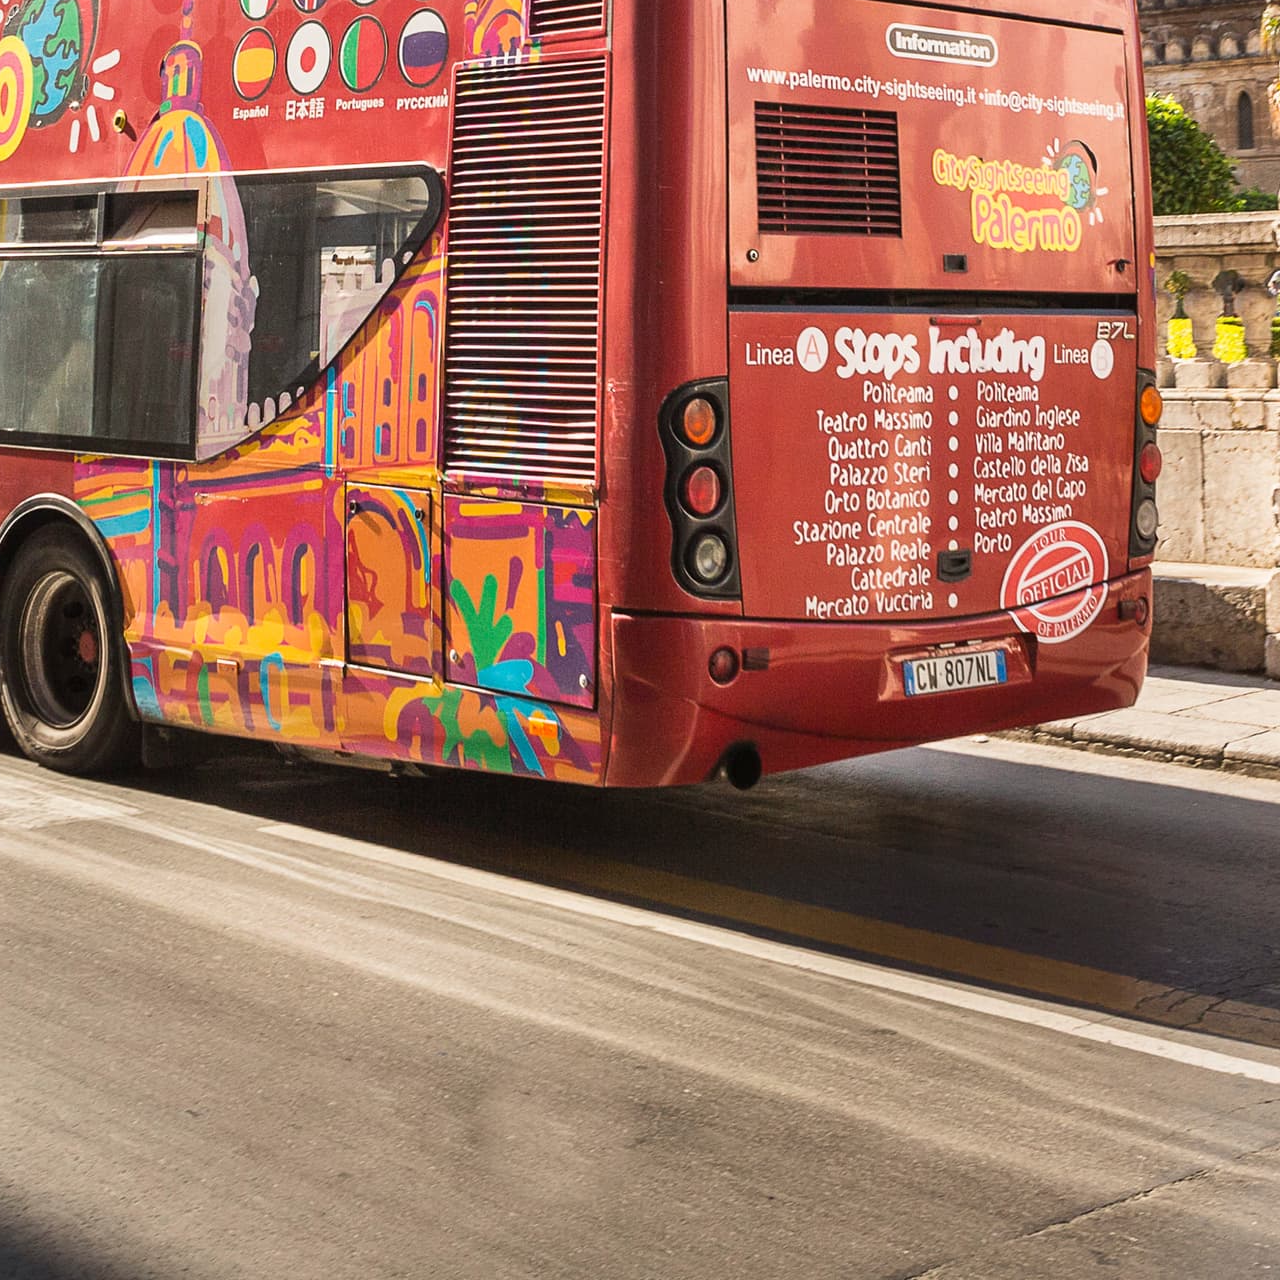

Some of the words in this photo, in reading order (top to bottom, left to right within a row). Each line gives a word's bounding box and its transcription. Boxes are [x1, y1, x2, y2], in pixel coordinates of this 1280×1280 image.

[895, 31, 991, 59] Information
[747, 67, 976, 107] www.palermo.city-sightseeing.it
[232, 105, 269, 120] Español
[285, 97, 325, 120] 日本語
[971, 189, 1082, 252] Palermo
[1096, 322, 1135, 339] B7L
[745, 342, 794, 366] Linea
[834, 326, 921, 381] Stops
[928, 326, 1046, 382] Including
[1053, 343, 1089, 364] Linea
[863, 380, 934, 404] Politeama
[977, 380, 1039, 403] Politeama
[816, 409, 868, 434] Teatro
[874, 408, 933, 431] Massimo
[976, 405, 1031, 428] Giardino
[1035, 404, 1081, 430] Inglese
[828, 436, 889, 462] Quattro
[894, 434, 932, 457] Canti
[975, 432, 1003, 454] Villa
[1008, 431, 1065, 452] Malfitano
[830, 462, 888, 487] Palazzo
[894, 461, 931, 485] Steri
[973, 456, 1026, 479] Castello
[1030, 454, 1061, 476] della
[1065, 452, 1089, 474] Zisa
[824, 489, 860, 514] Orto
[866, 488, 930, 511] Botanico
[974, 482, 1027, 505] Mercato
[1031, 479, 1053, 501] del
[1056, 476, 1086, 500] Capo
[793, 519, 862, 545] Stazione
[867, 511, 932, 537] Centrale
[974, 506, 1017, 530] Teatro
[826, 542, 885, 566] Palazzo
[890, 538, 931, 562] Reale
[974, 531, 1012, 554] Porto
[1032, 527, 1067, 553] TOUR
[851, 563, 932, 591] Cattedrale
[1021, 559, 1090, 606] OFFICIAL
[805, 594, 869, 619] Mercato
[875, 590, 933, 614] Vucciria
[1038, 621, 1052, 637] OF
